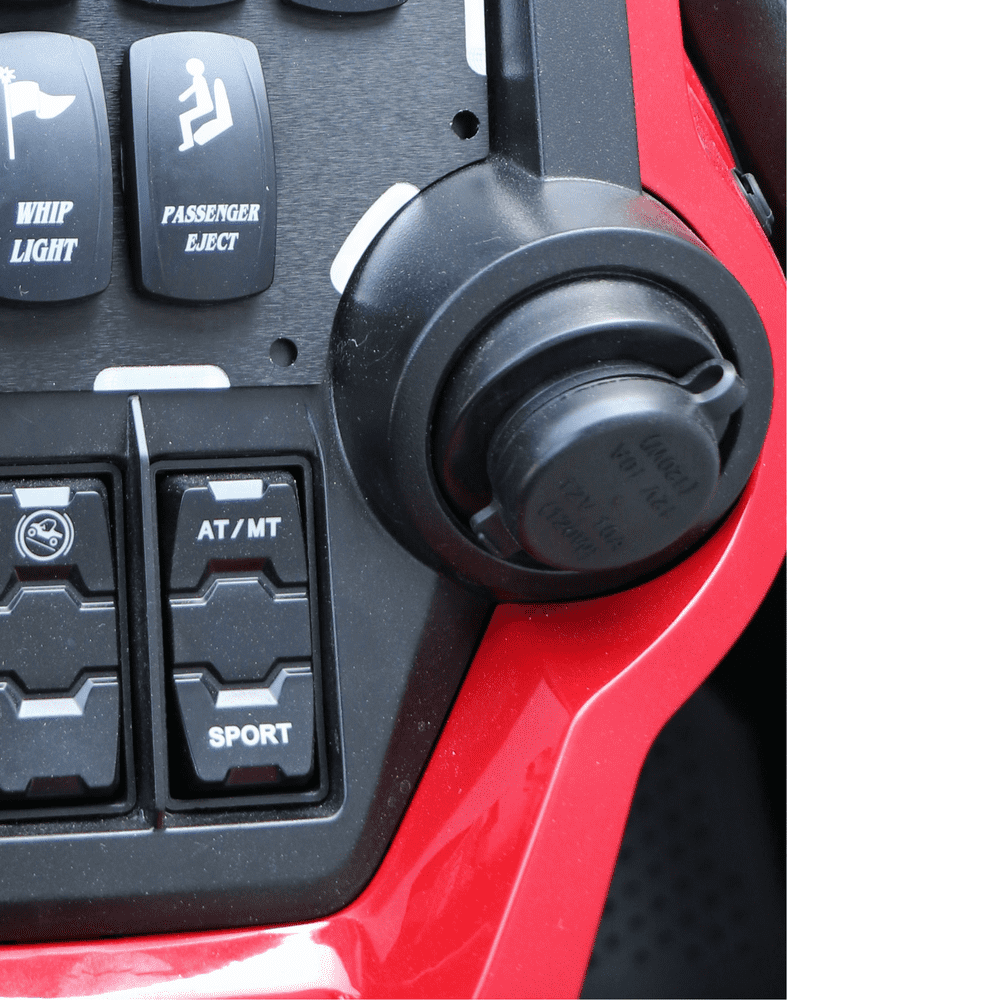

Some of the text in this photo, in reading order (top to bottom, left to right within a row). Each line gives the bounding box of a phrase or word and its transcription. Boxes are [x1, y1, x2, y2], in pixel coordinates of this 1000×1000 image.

[15, 200, 74, 225] WHIP
[160, 203, 261, 225] PASSENGER
[9, 237, 79, 264] LIGHT
[184, 232, 240, 252] EJECT
[197, 516, 282, 541] AT/MT
[207, 722, 293, 749] SPORT
